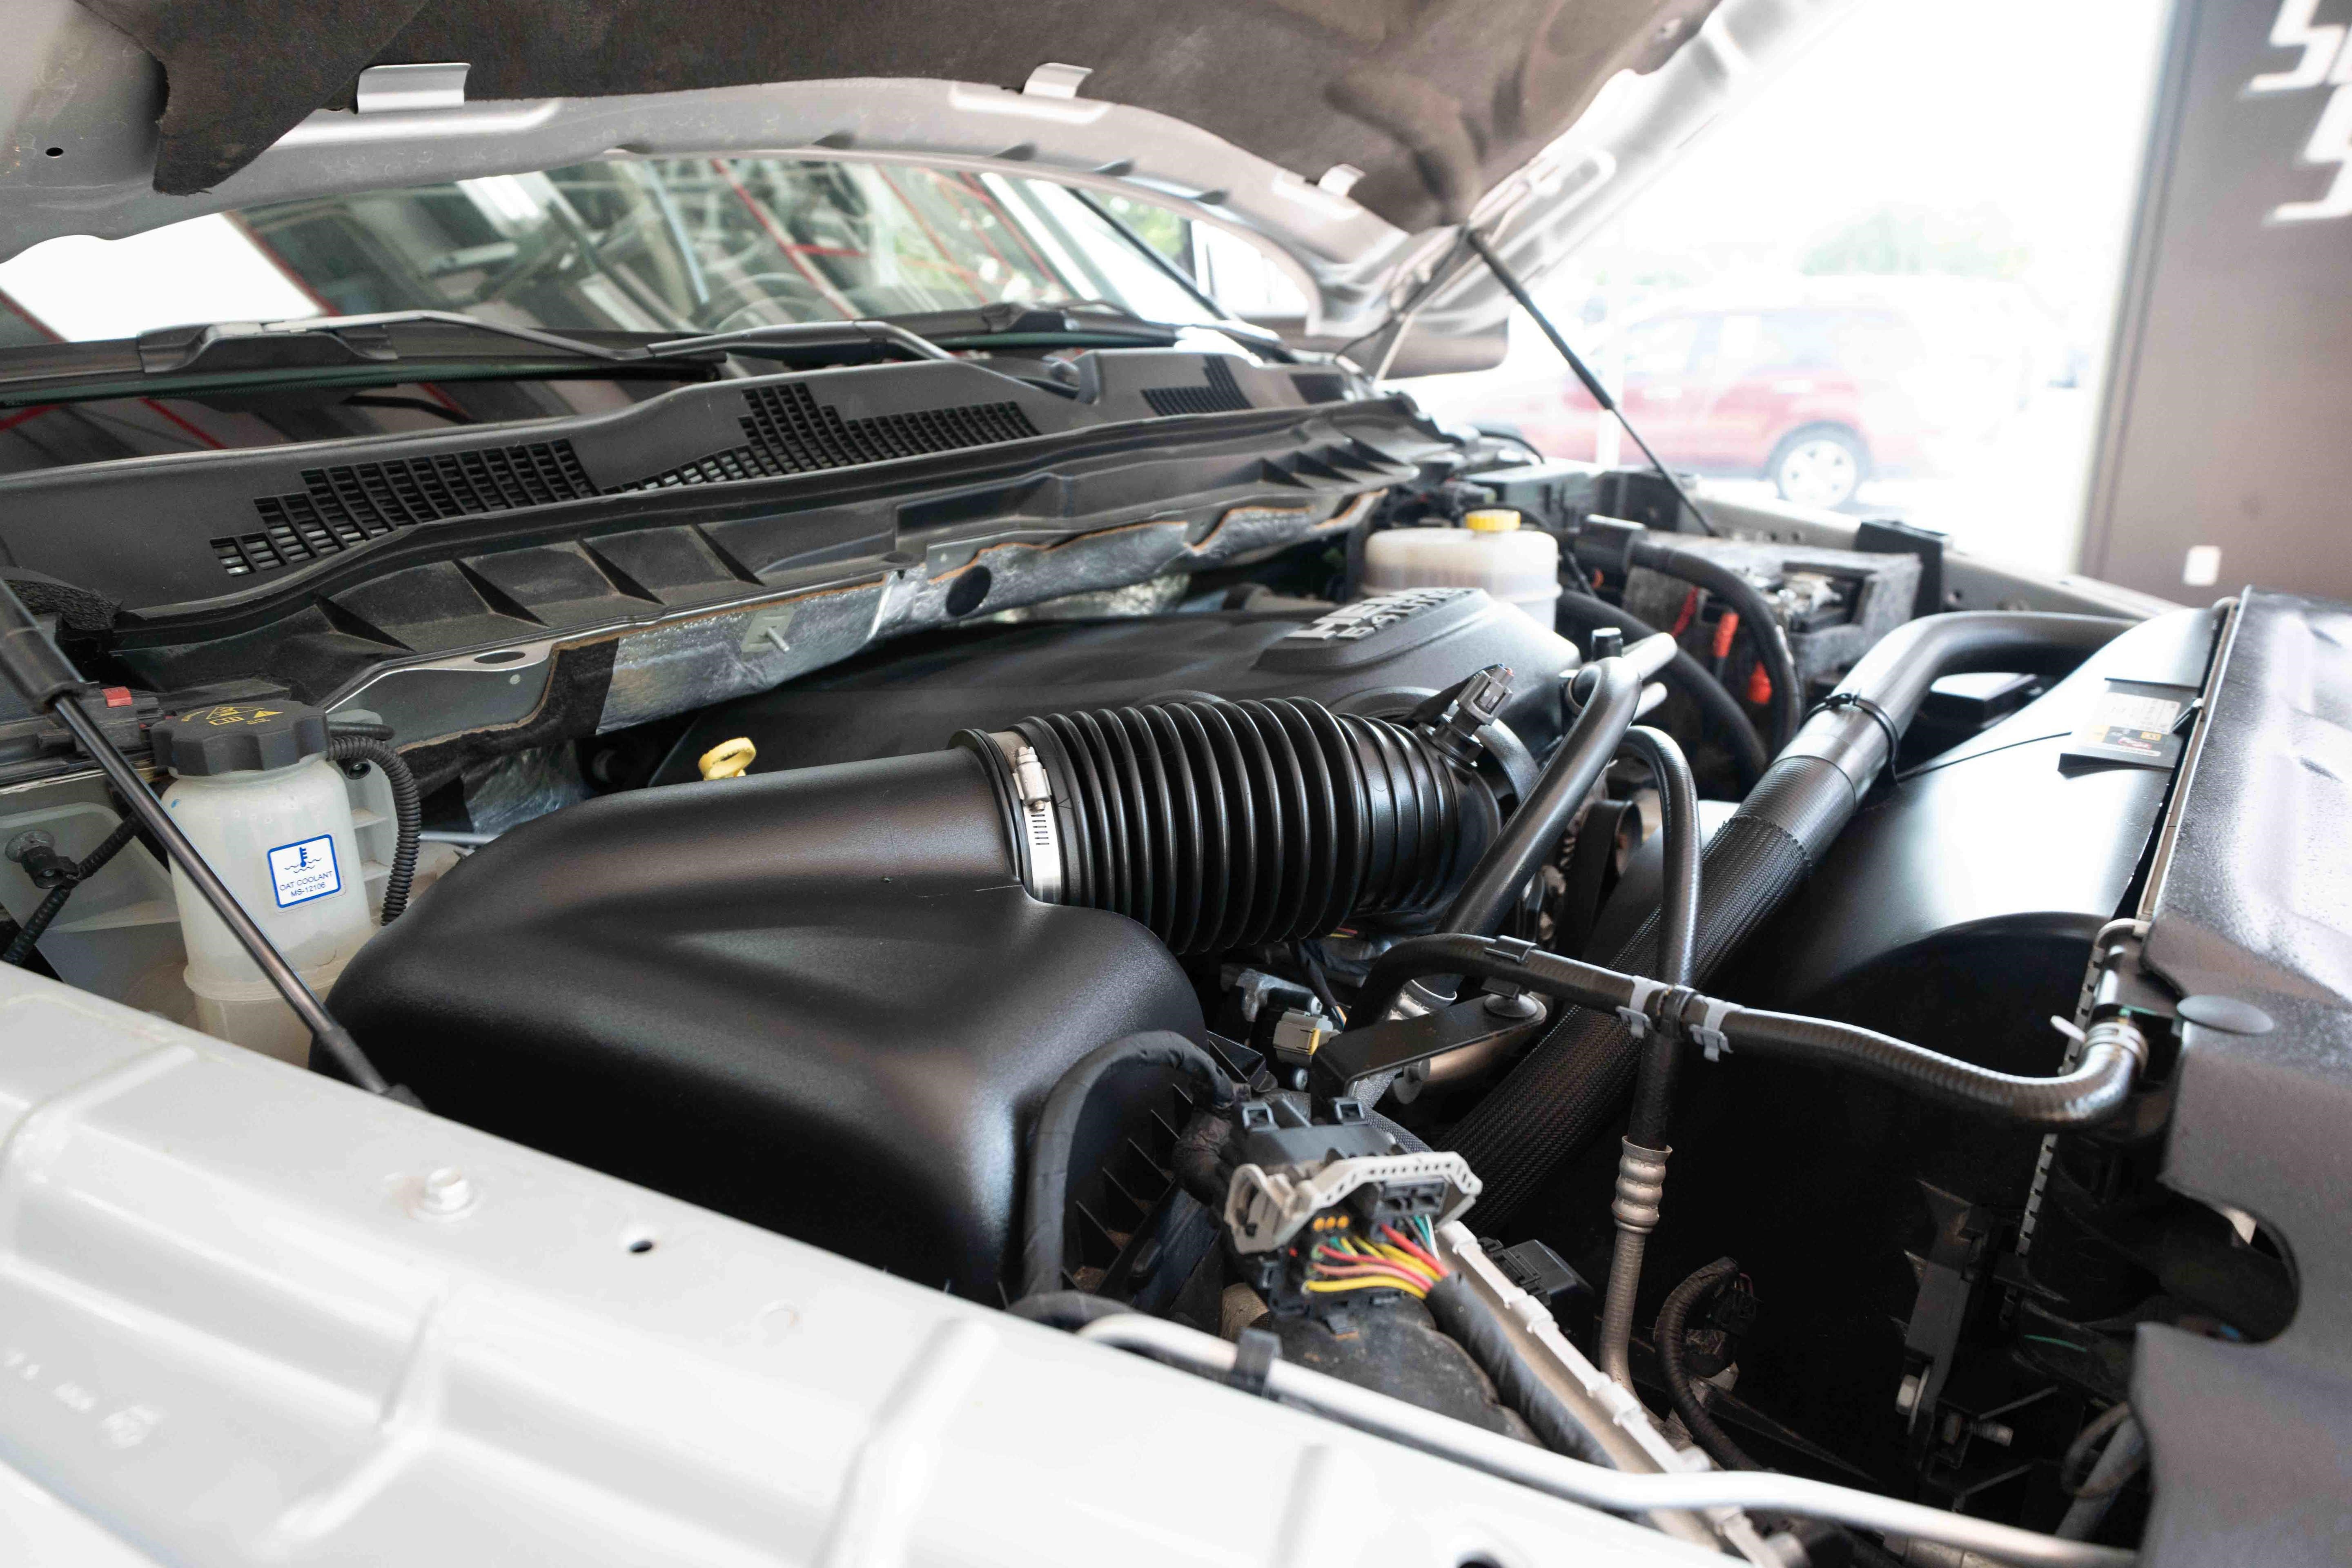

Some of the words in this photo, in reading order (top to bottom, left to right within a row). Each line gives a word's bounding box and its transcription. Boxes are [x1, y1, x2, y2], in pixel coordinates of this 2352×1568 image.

[280, 882, 294, 891] OAT
[297, 871, 333, 886] COOLANT
[291, 882, 325, 897] MS-12106
